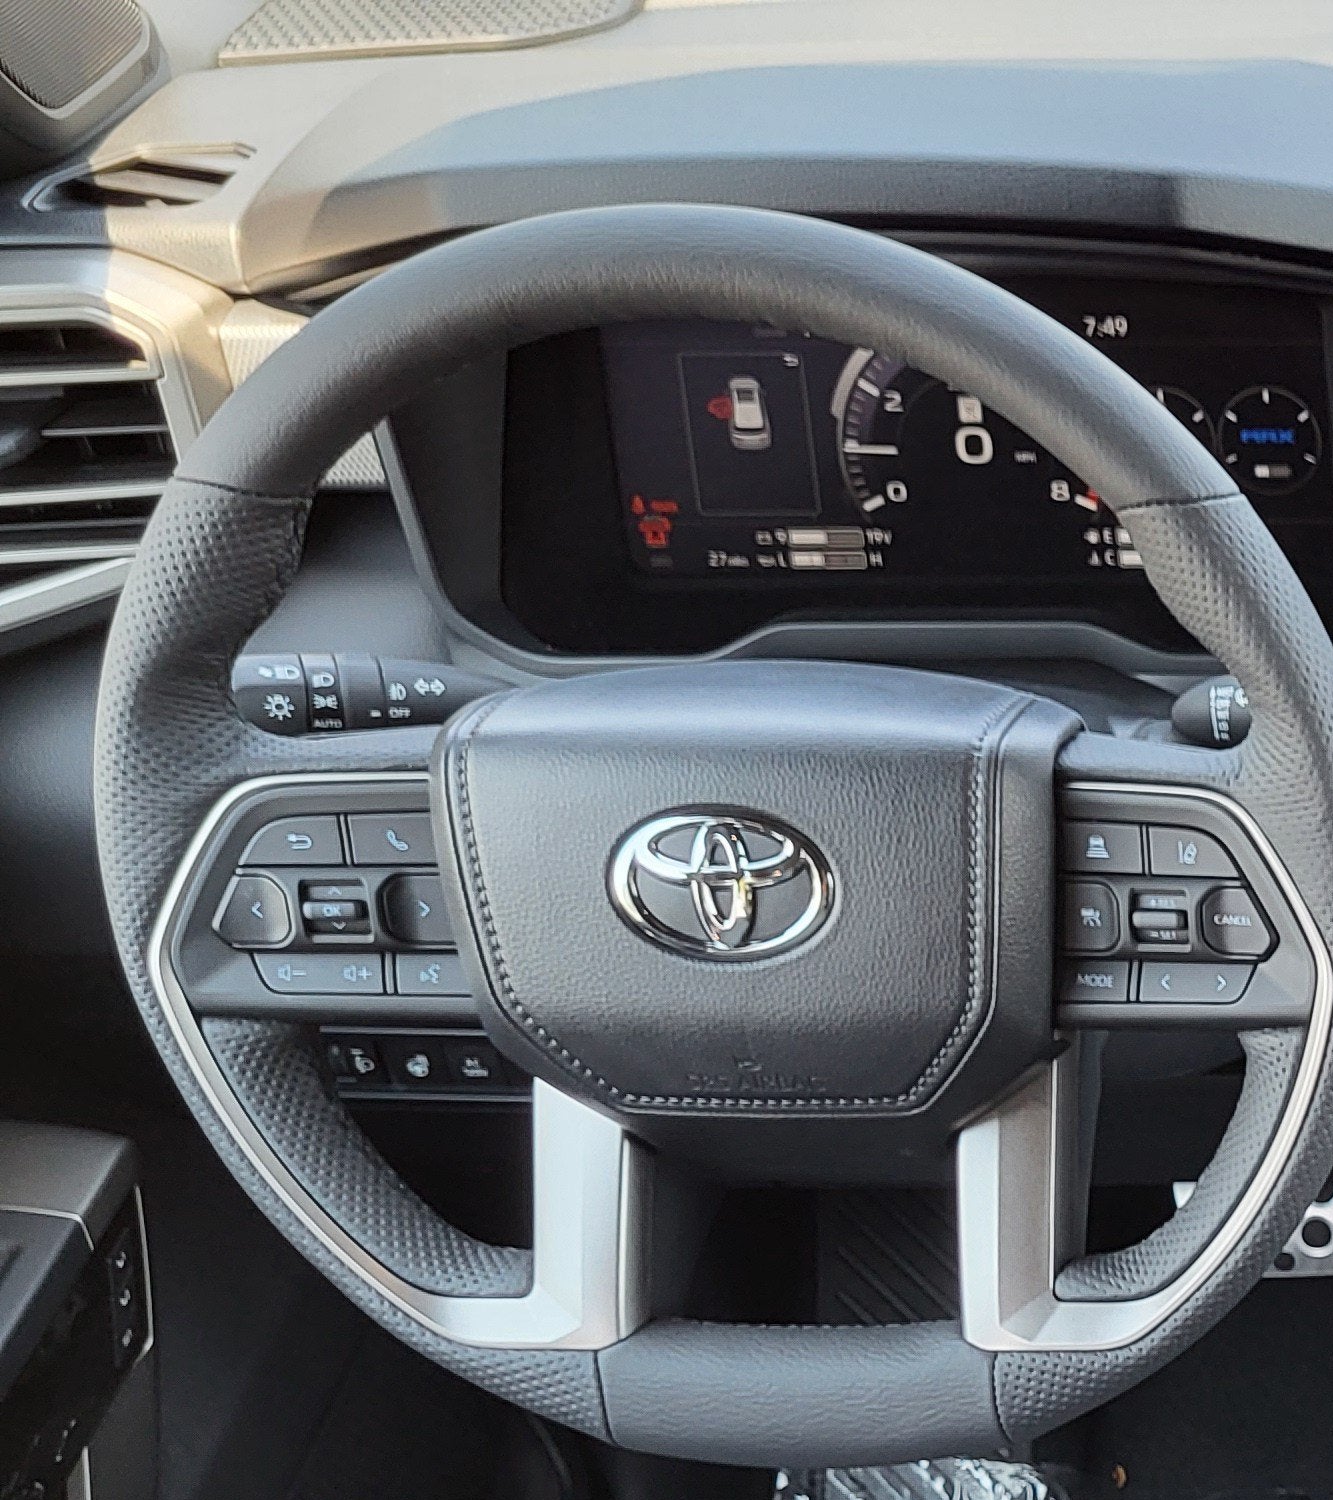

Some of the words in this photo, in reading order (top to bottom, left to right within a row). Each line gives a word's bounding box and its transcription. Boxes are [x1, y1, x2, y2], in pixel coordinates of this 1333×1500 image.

[1083, 315, 1128, 338] 7:49
[884, 389, 904, 413] 2
[313, 718, 343, 729] AUTO
[322, 904, 341, 918] OK
[1077, 973, 1114, 989] MODE
